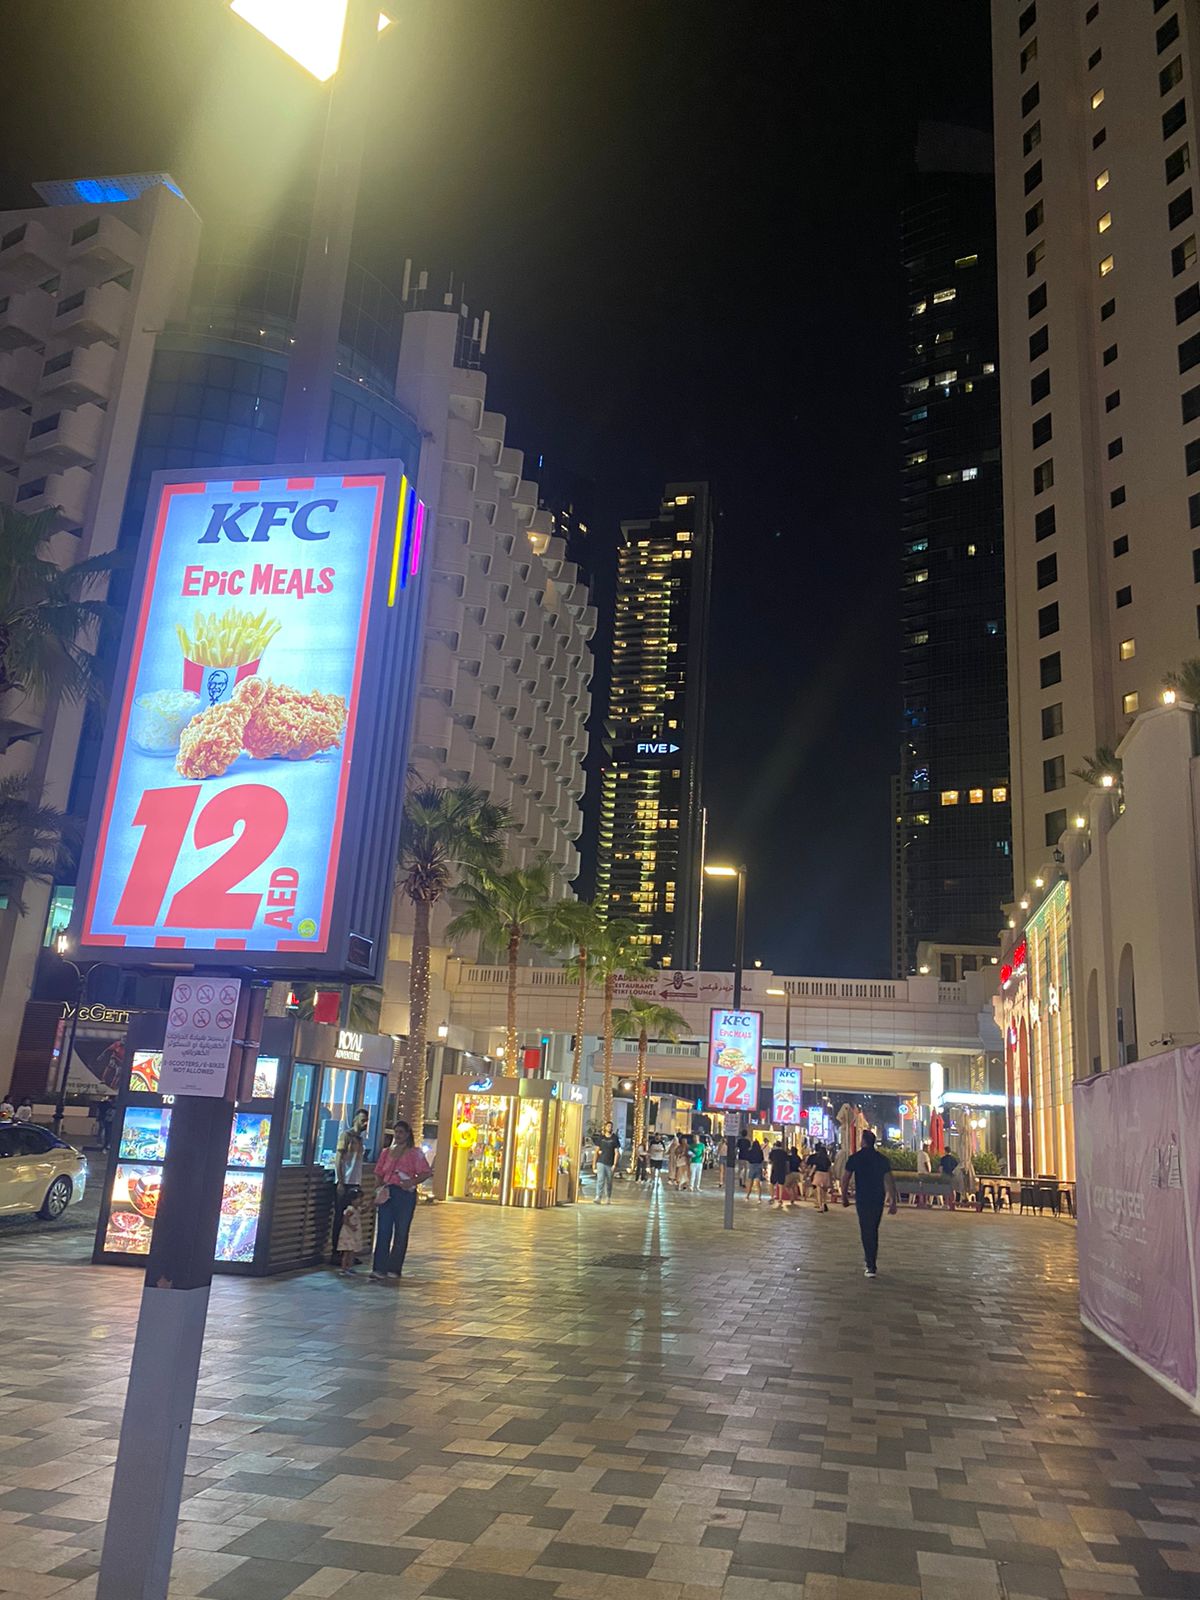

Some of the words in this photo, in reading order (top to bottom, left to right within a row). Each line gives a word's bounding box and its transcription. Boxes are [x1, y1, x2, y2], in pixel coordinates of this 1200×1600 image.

[198, 499, 337, 544] KFC
[250, 564, 335, 600] MEALS
[637, 743, 668, 754] FIVE
[113, 783, 289, 929] 12
[264, 866, 300, 930] AED
[722, 1015, 751, 1026] KFC
[338, 1030, 363, 1052] ROYAL
[187, 1067, 214, 1075] ALLOWED
[714, 1076, 747, 1105] 12
[776, 1105, 795, 1120] 12
